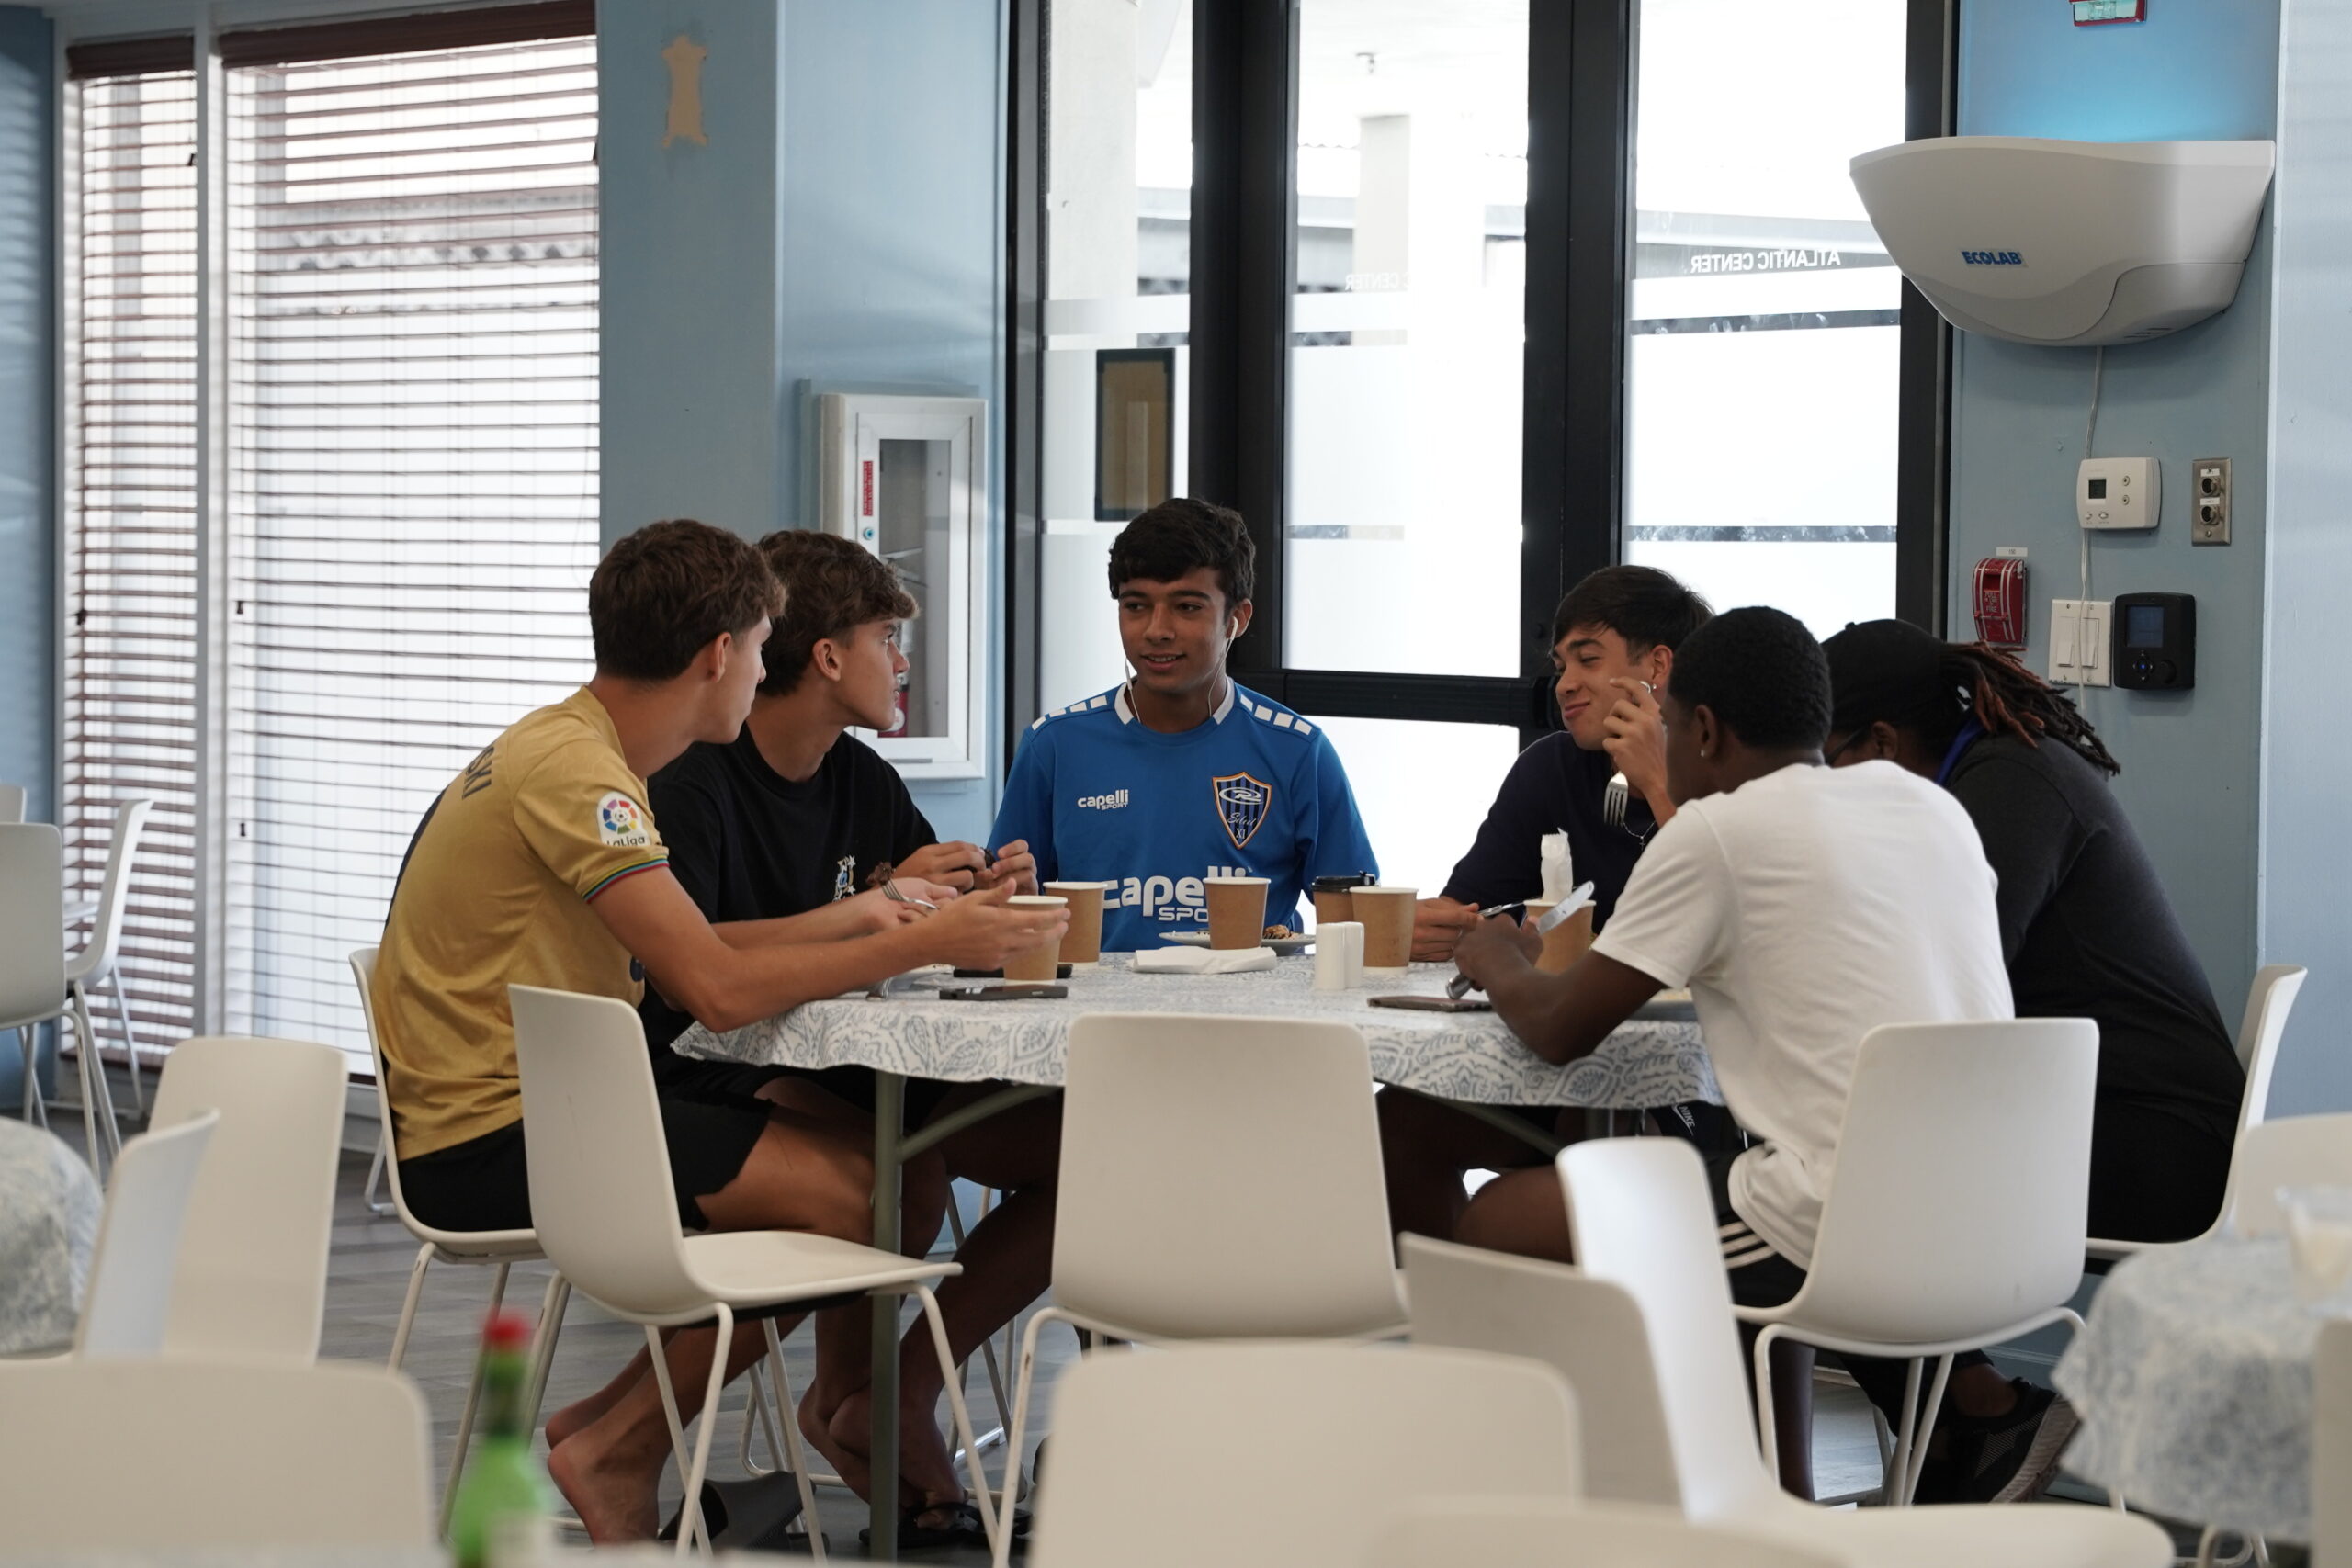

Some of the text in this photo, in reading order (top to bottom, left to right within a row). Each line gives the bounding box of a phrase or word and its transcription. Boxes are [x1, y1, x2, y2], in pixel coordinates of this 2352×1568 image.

[1961, 251, 2023, 265] ECOLAB
[1077, 789, 1129, 810] capelli
[1103, 865, 1247, 918] cape
[1158, 907, 1209, 923] SPO
[1679, 1105, 1696, 1128] NIKE
